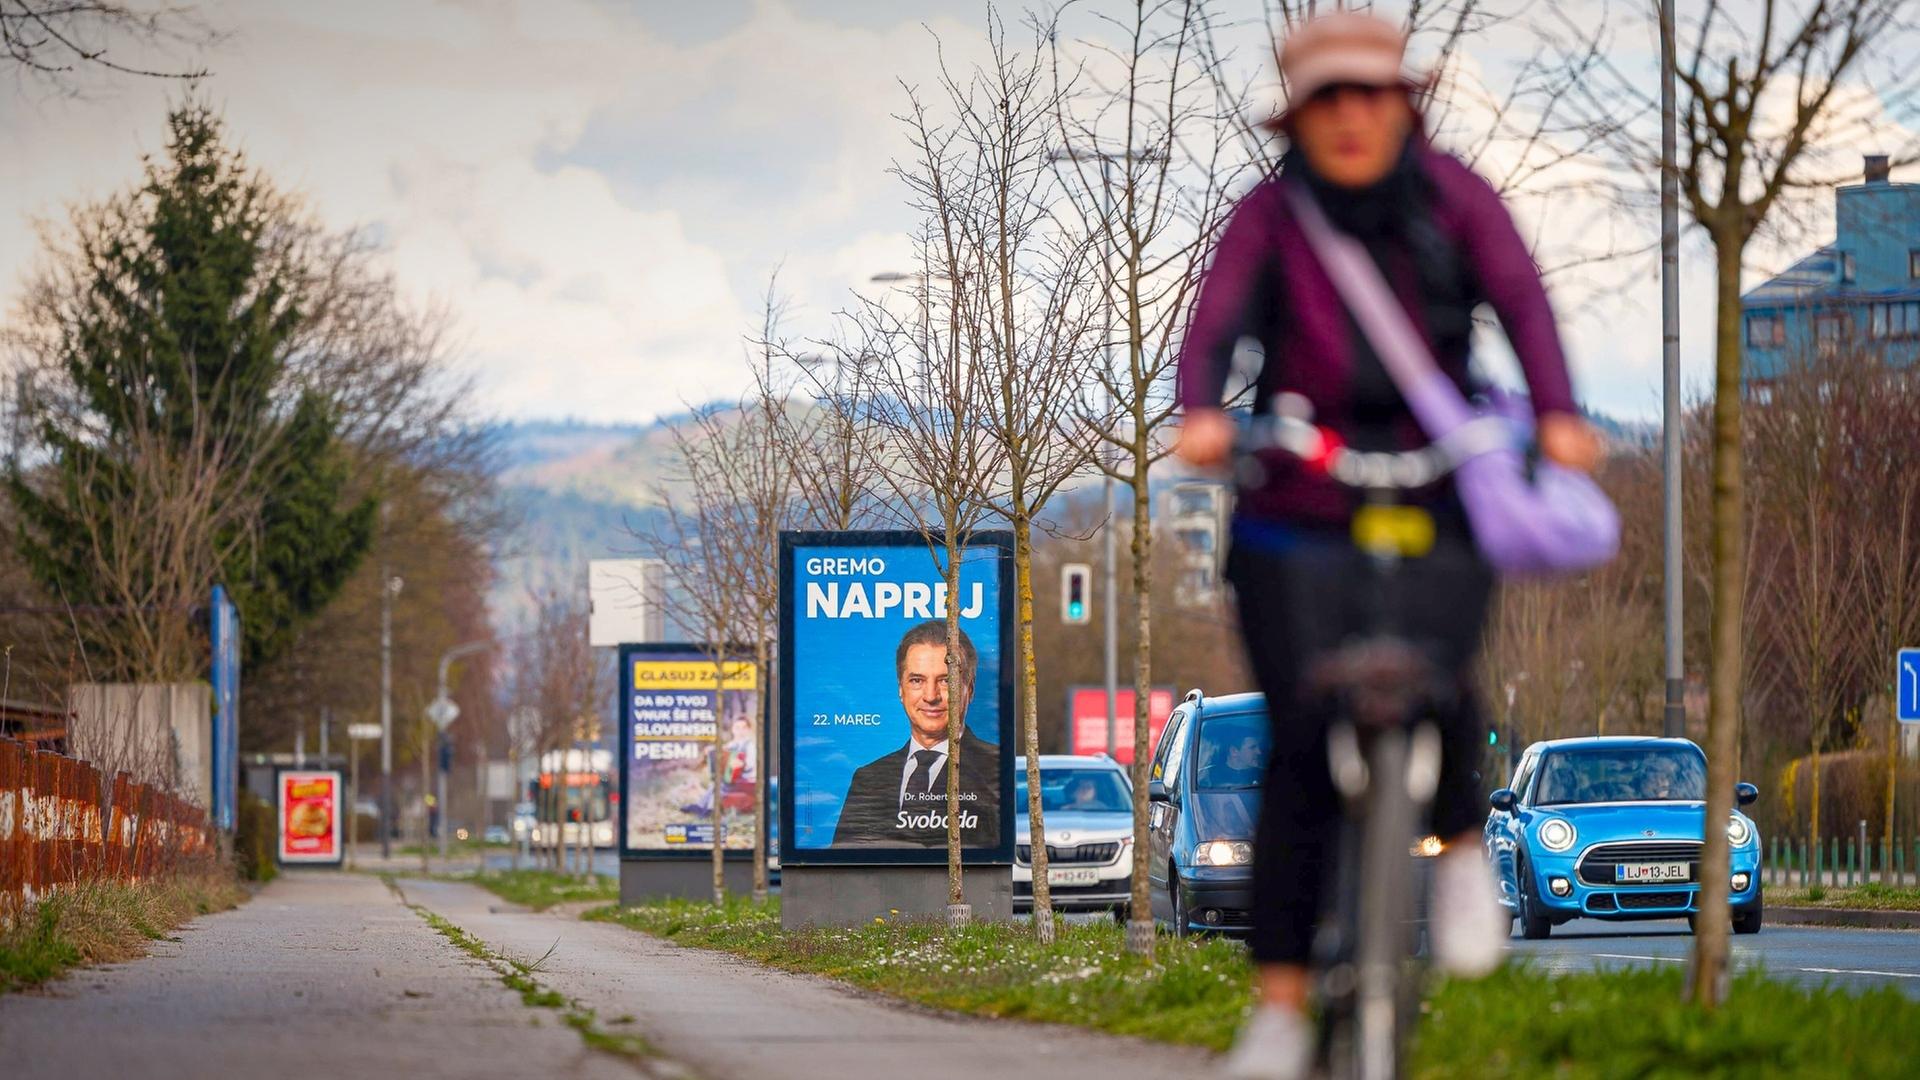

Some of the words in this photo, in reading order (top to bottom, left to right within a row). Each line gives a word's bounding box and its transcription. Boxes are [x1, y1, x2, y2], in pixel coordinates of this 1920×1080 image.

[806, 558, 885, 575] GREMO
[806, 582, 983, 619] NAPREJ
[634, 695, 653, 707] DA
[654, 695, 674, 707] BO
[675, 695, 708, 707] TVOJ
[634, 709, 671, 721] VNUK
[672, 707, 689, 721] ŠE
[690, 709, 716, 721] PEL
[813, 714, 831, 726] 22.
[834, 714, 881, 726] MAREC
[634, 742, 699, 760] PESMI
[904, 792, 916, 801] Dr.
[919, 792, 949, 801] Robert
[956, 792, 978, 801] olob
[1627, 866, 1641, 878] LJ
